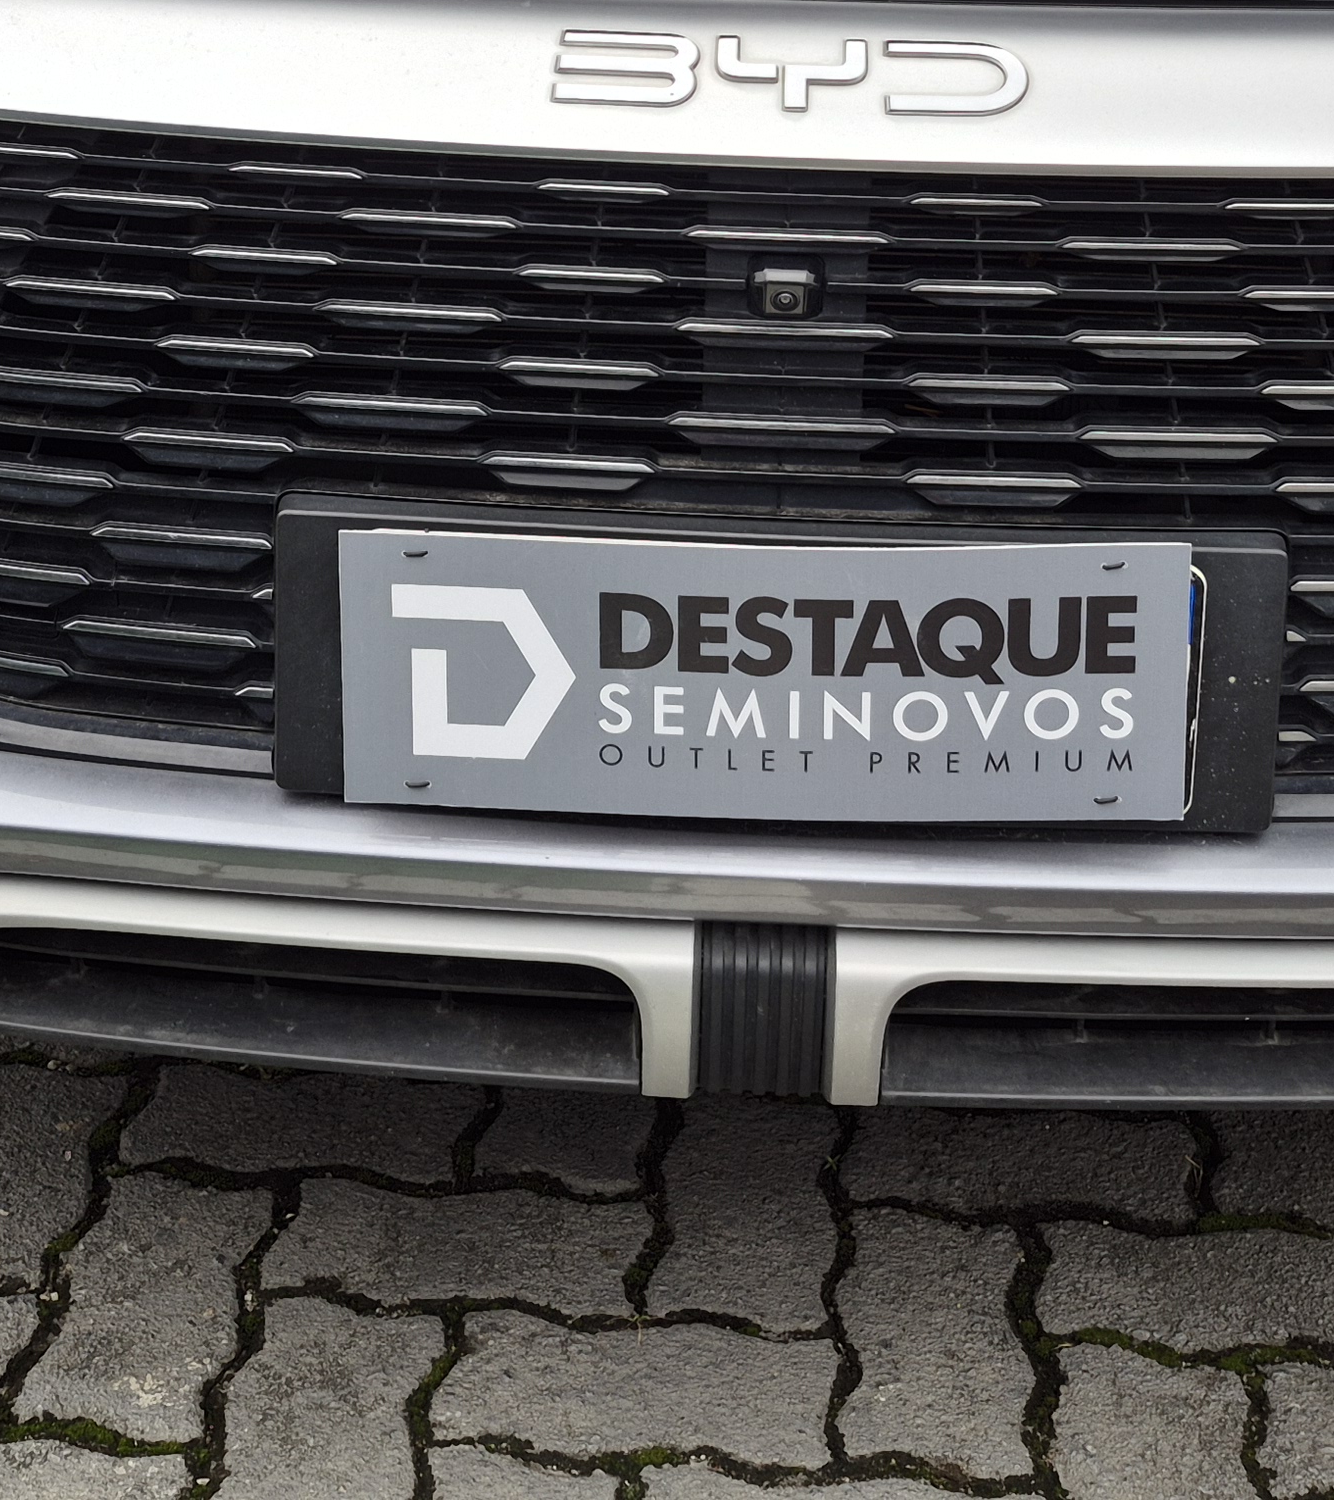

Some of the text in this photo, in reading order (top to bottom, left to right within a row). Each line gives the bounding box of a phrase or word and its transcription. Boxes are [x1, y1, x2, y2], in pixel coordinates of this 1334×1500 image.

[550, 29, 1030, 118] BYD
[598, 592, 1137, 684] DESTAQUE
[599, 681, 1134, 741] SEMINOVOS
[599, 743, 1135, 774] OUTLET PREMIUM
